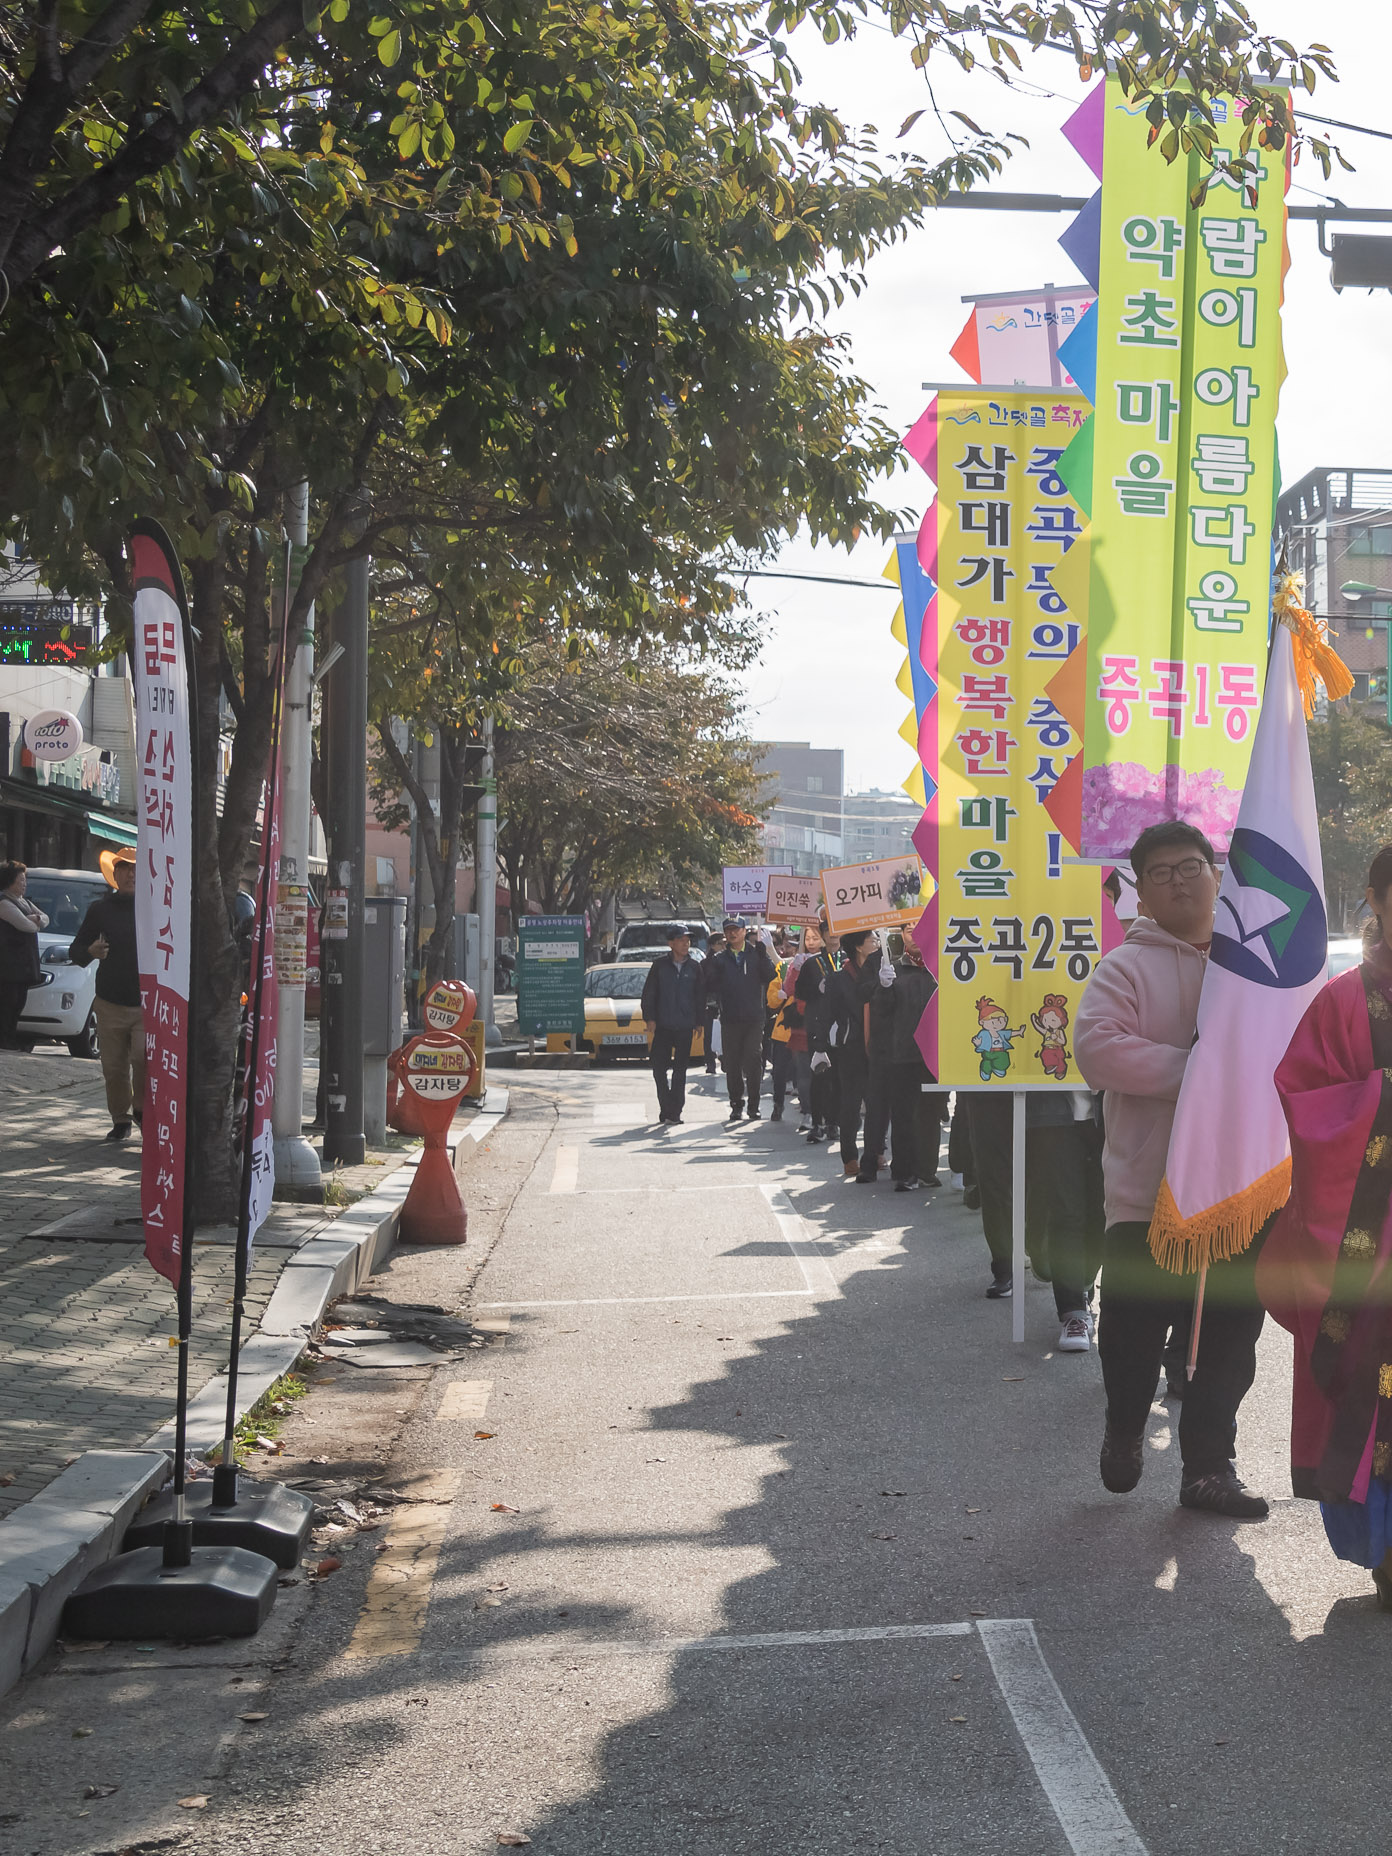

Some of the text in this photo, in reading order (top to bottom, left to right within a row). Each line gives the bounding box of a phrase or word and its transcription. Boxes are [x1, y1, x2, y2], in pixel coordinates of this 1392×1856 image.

[1113, 216, 1185, 517] 약초 마을
[1187, 366, 1261, 633] 아름다운
[955, 444, 1018, 899] 삼대가 행복한 마을
[1096, 654, 1261, 744] 중곡1동
[35, 740, 69, 751] proto
[729, 880, 764, 896] 하수오
[775, 891, 811, 908] 인진쑥
[835, 882, 883, 907] 오가피
[944, 913, 1099, 983] 중곡2동
[429, 1009, 456, 1025] 감자탕
[414, 1077, 462, 1091] 감자탕
